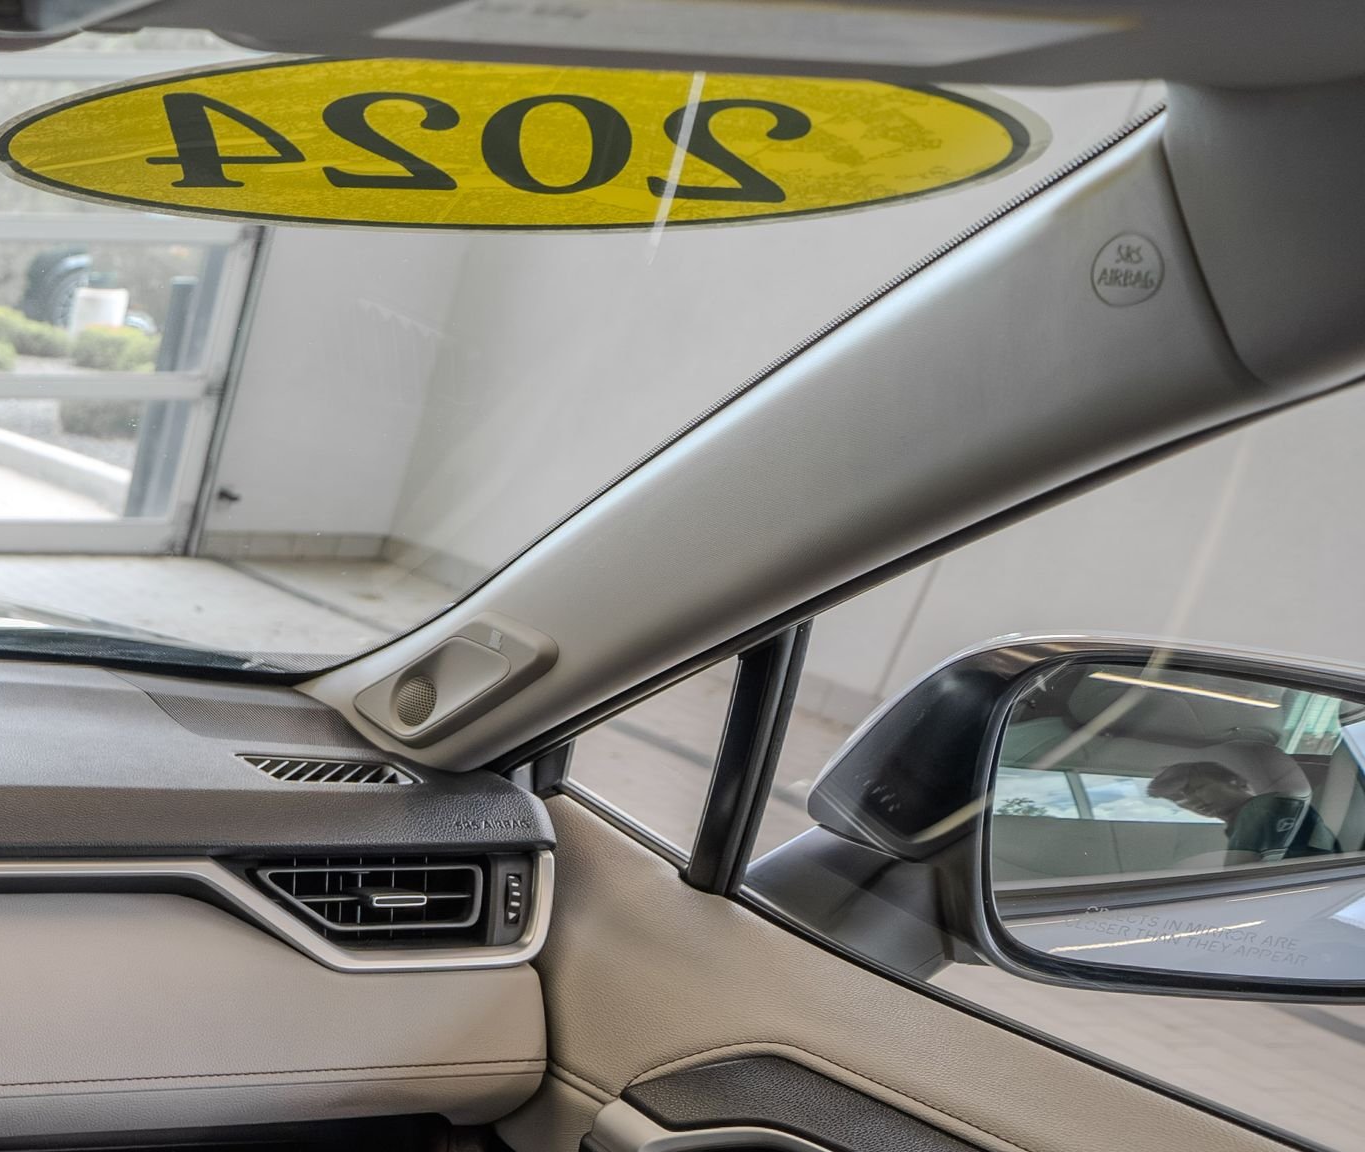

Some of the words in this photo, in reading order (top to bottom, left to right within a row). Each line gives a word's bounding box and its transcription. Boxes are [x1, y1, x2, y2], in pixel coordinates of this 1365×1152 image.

[1096, 267, 1155, 289] AIRBAG
[1164, 919, 1183, 932] IN
[1261, 935, 1299, 950] ARE
[1185, 936, 1232, 953] THEY
[1233, 945, 1309, 966] APPEAR
